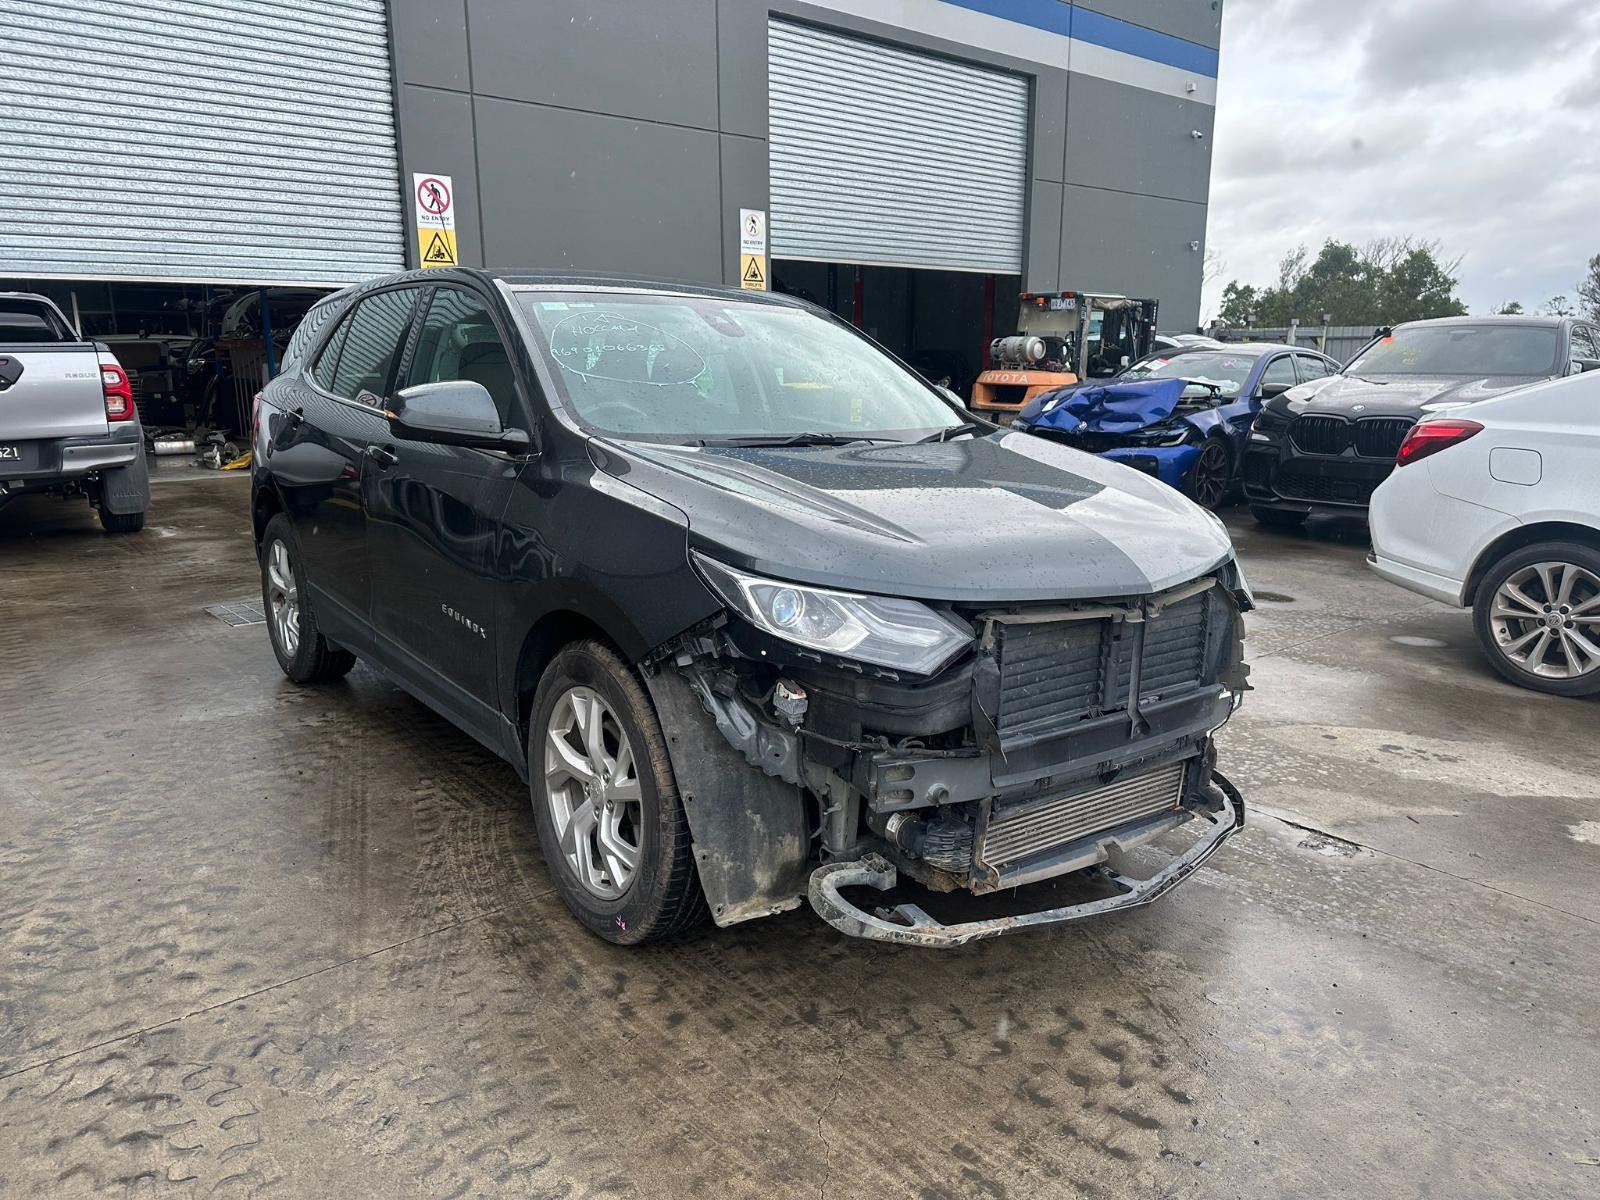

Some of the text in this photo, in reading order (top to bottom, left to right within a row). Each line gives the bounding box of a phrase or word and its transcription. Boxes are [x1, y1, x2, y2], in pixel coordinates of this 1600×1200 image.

[982, 372, 1029, 384] TOYOTA
[0, 447, 18, 458] 21
[441, 603, 487, 639] EQUINOX
